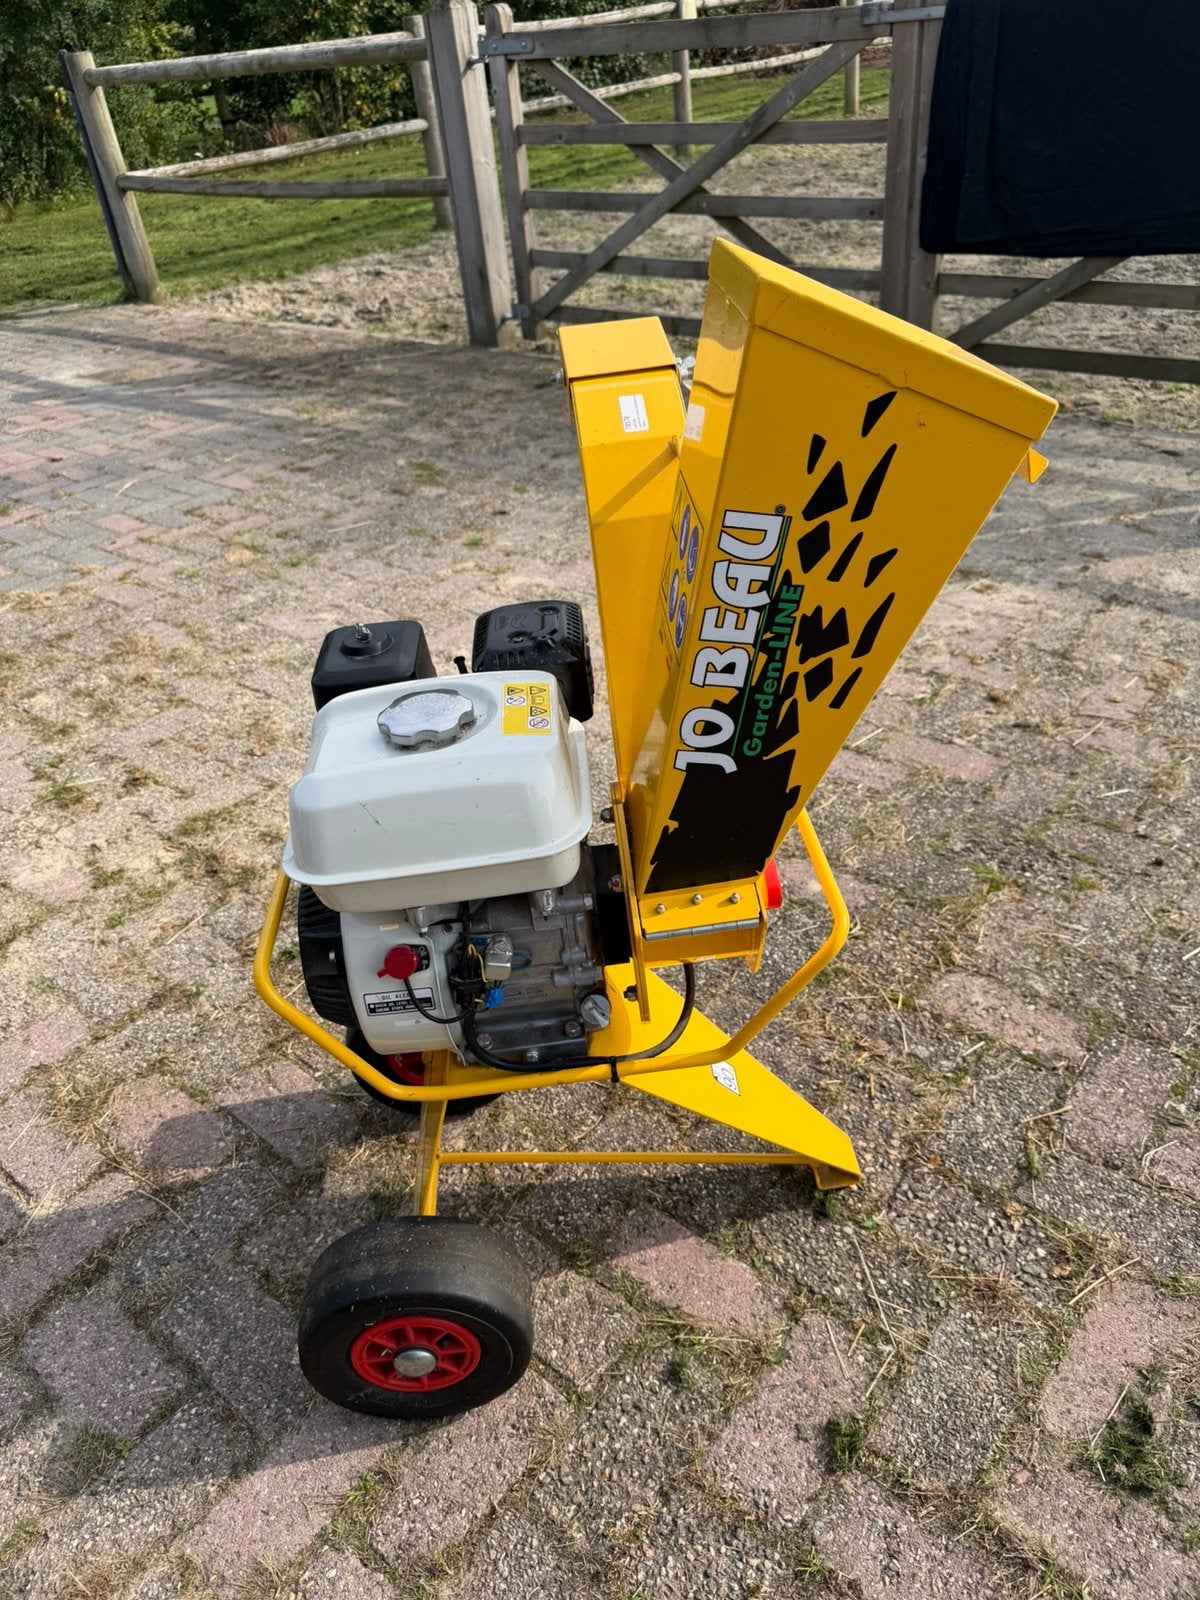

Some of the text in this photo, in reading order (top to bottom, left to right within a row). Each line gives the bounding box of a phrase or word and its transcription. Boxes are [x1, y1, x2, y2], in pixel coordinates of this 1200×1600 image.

[673, 508, 786, 775] JO BEAU
[743, 584, 803, 757] Garden-LINE
